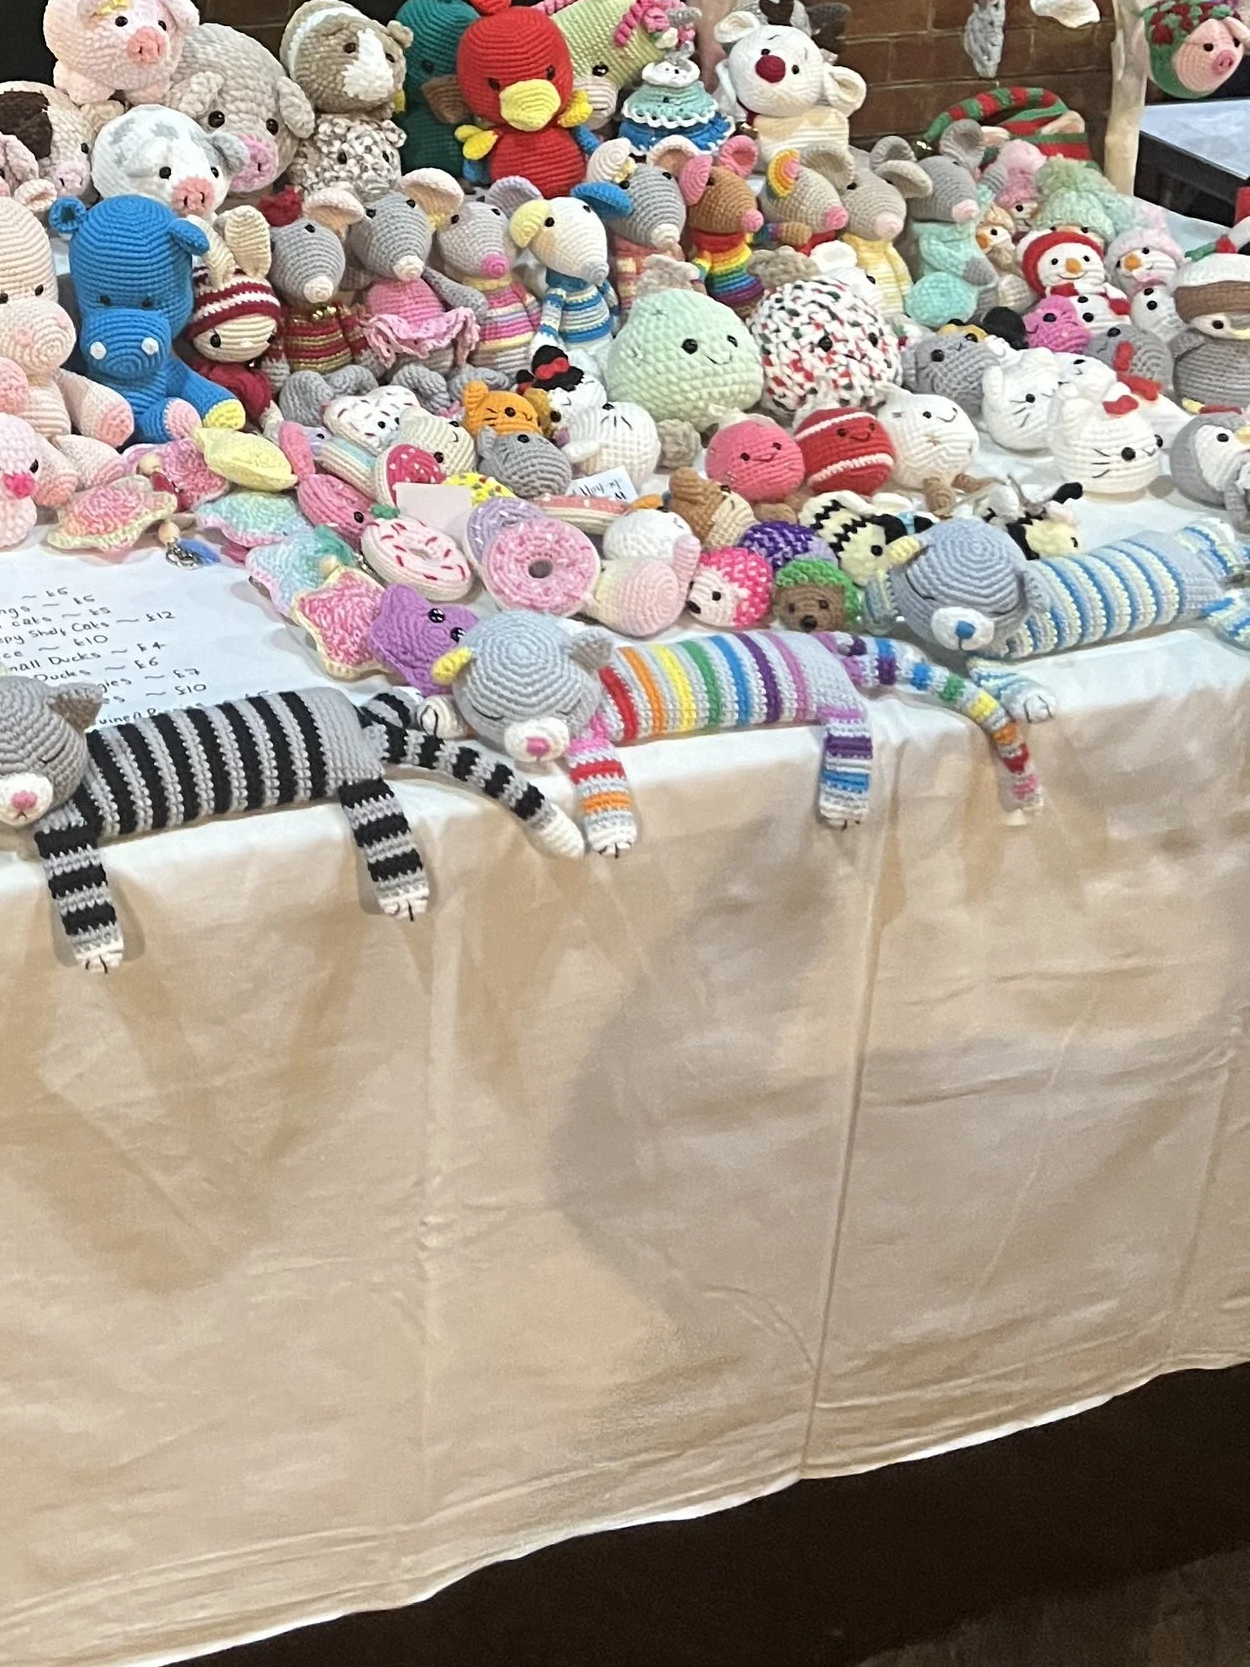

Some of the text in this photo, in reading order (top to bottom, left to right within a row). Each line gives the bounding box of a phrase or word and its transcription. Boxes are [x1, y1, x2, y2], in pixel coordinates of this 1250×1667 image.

[71, 620, 110, 633] Cats
[145, 610, 176, 623] £12
[72, 634, 109, 647] £10
[8, 659, 42, 673] mall
[48, 652, 102, 666] Ducks
[136, 640, 167, 652] £4
[133, 656, 159, 670] £6
[174, 683, 208, 696] £10
